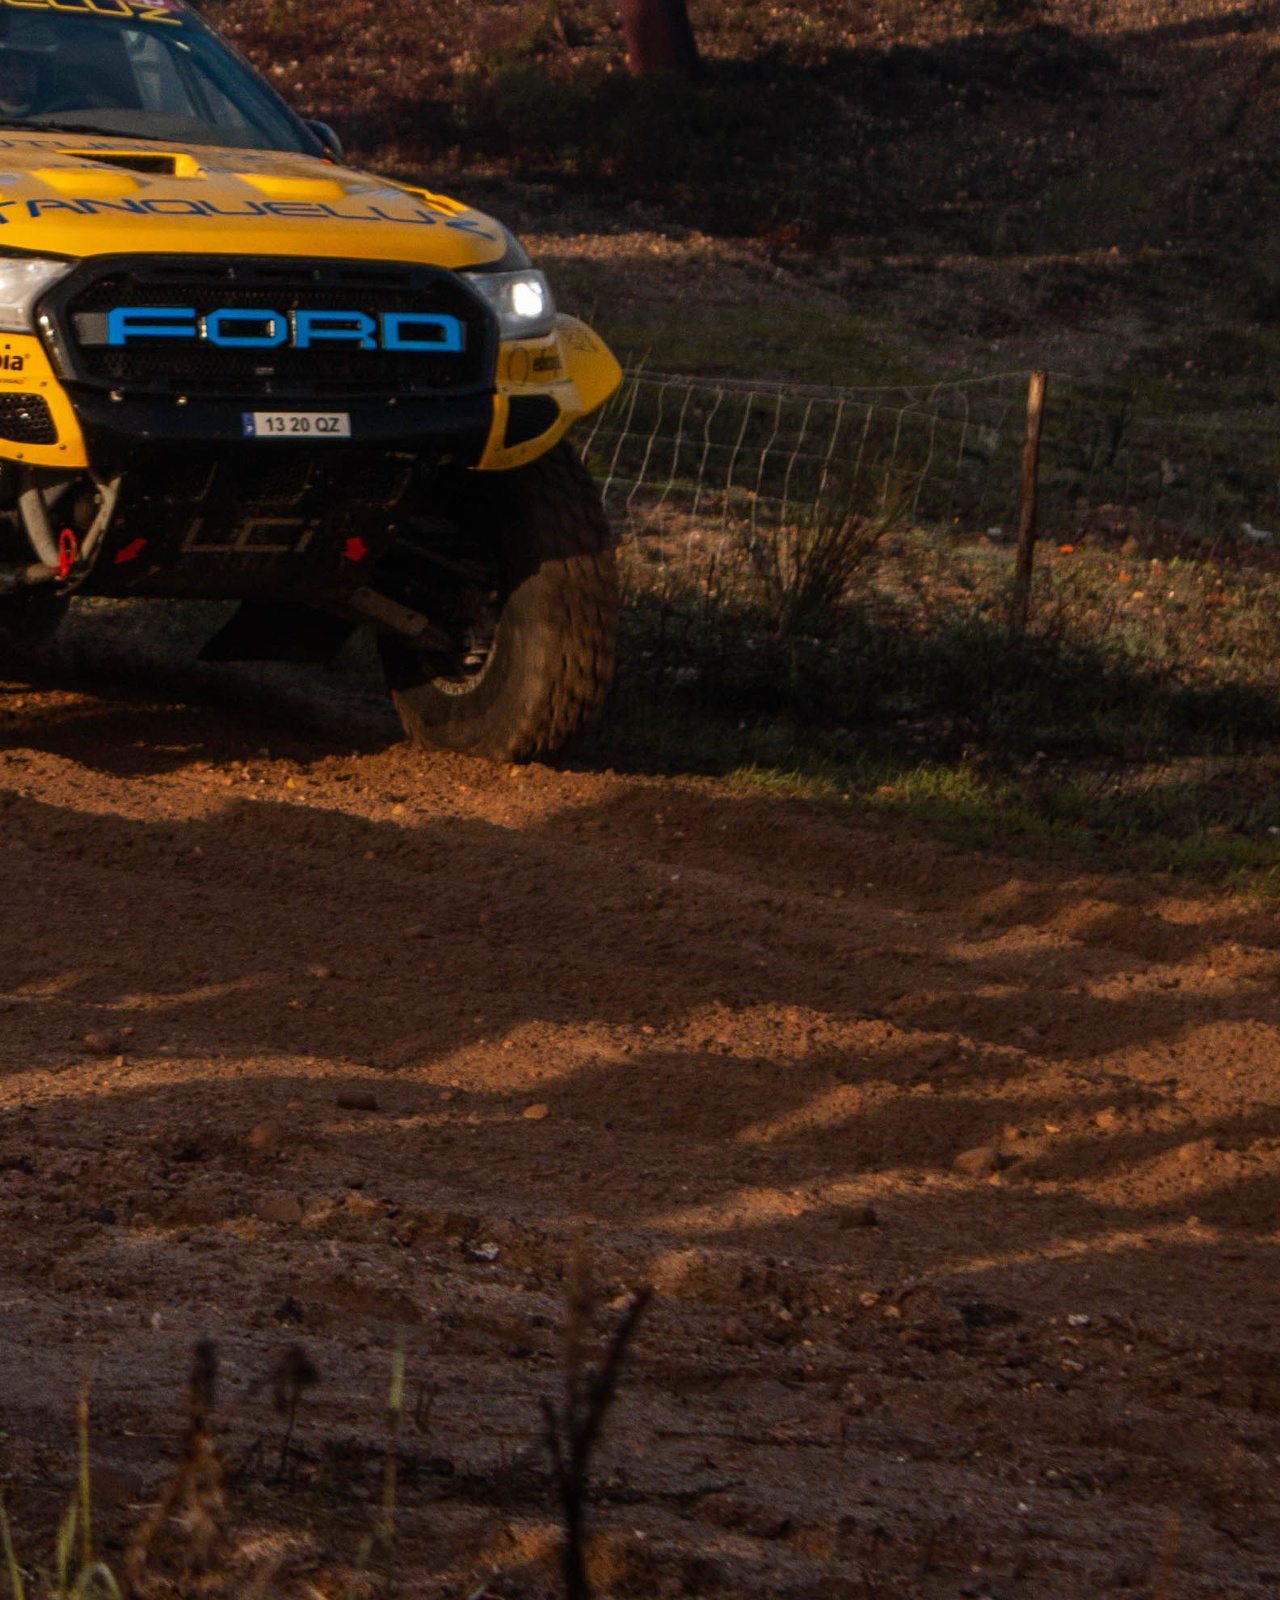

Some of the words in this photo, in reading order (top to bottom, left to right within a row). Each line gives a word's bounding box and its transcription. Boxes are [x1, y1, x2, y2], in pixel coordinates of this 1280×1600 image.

[107, 307, 462, 352] FORD
[265, 417, 285, 432] 13
[290, 417, 311, 432] 20
[315, 417, 341, 432] QZ
